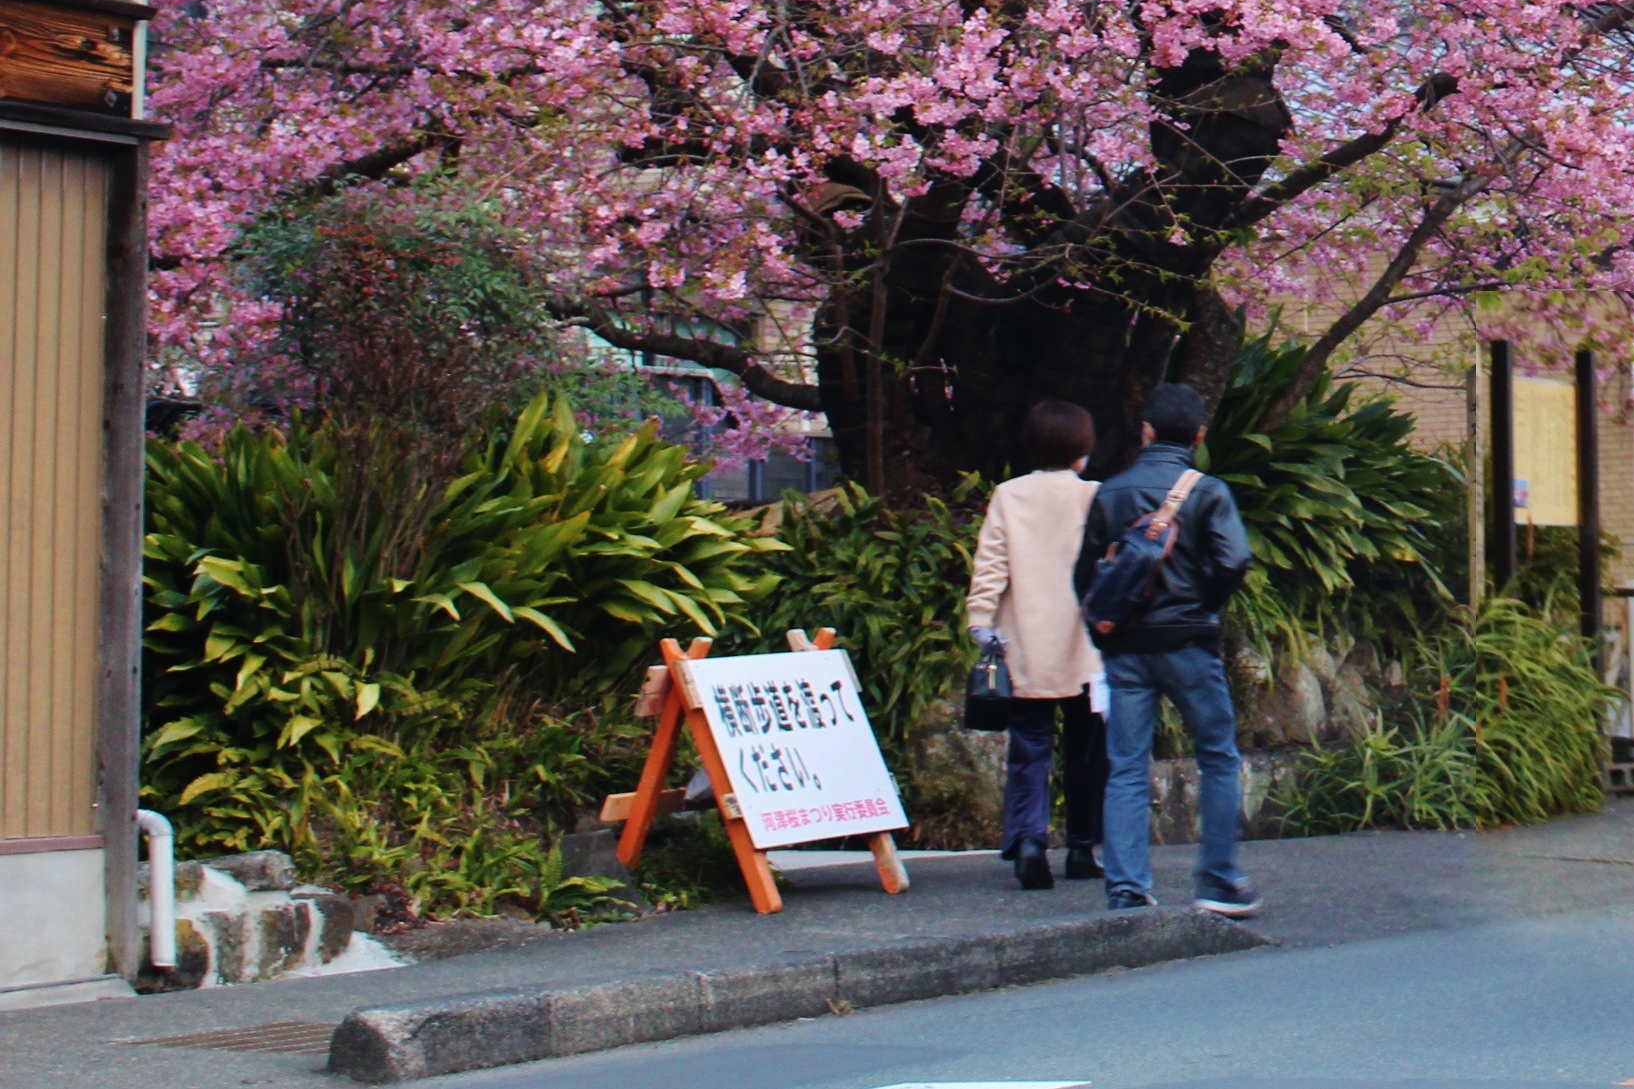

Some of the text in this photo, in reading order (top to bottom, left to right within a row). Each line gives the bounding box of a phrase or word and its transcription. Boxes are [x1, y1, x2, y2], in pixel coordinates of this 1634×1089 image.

[712, 678, 854, 737] 横断歩道を渡って
[761, 797, 890, 831] 河津桜まつり実行委員会
